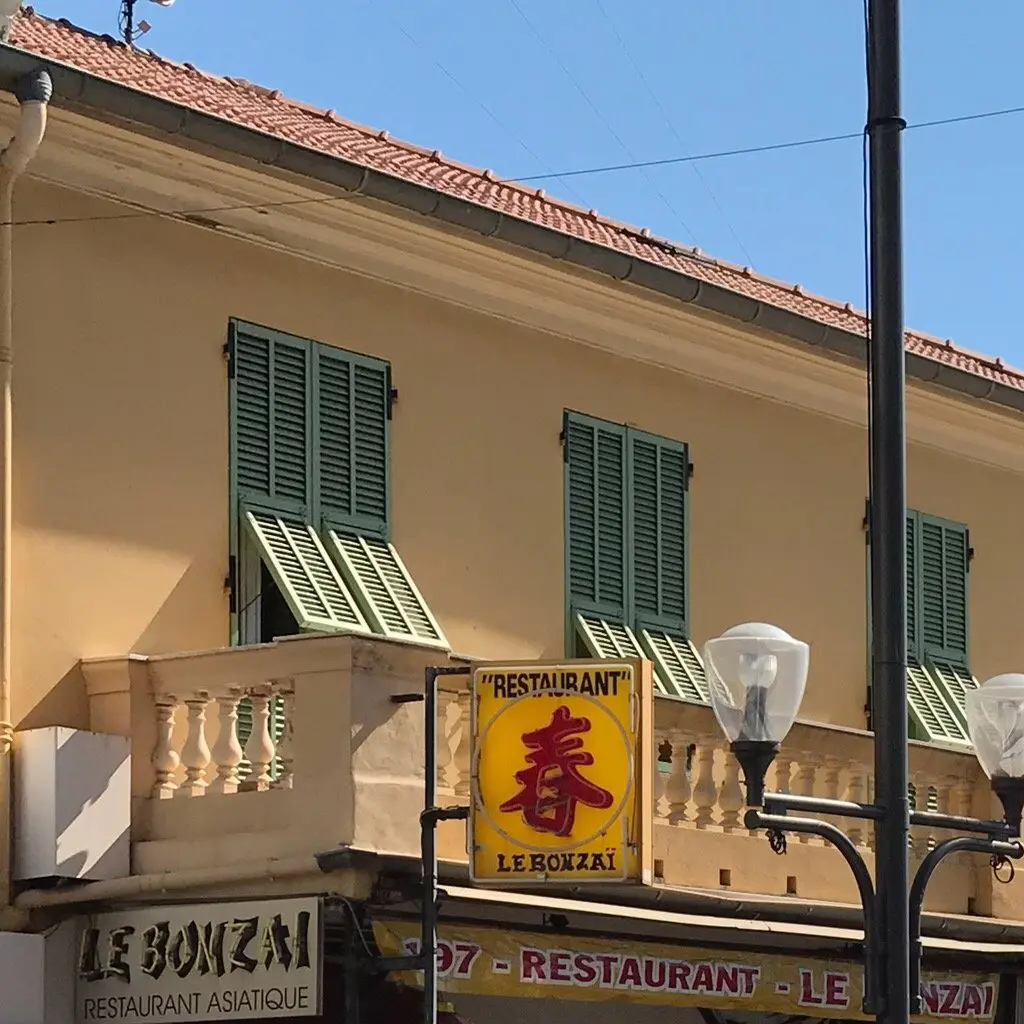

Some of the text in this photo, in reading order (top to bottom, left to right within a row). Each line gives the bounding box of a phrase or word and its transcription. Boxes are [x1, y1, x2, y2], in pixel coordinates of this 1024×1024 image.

[500, 705, 614, 837] 春
[497, 854, 524, 872] LE
[79, 911, 311, 984] LE BONZAI
[521, 947, 758, 994] RESTAURANT
[800, 971, 849, 1006] LE
[919, 979, 993, 1017] NZAI
[84, 986, 309, 1020] RESTAURANT ASIATIQUE
